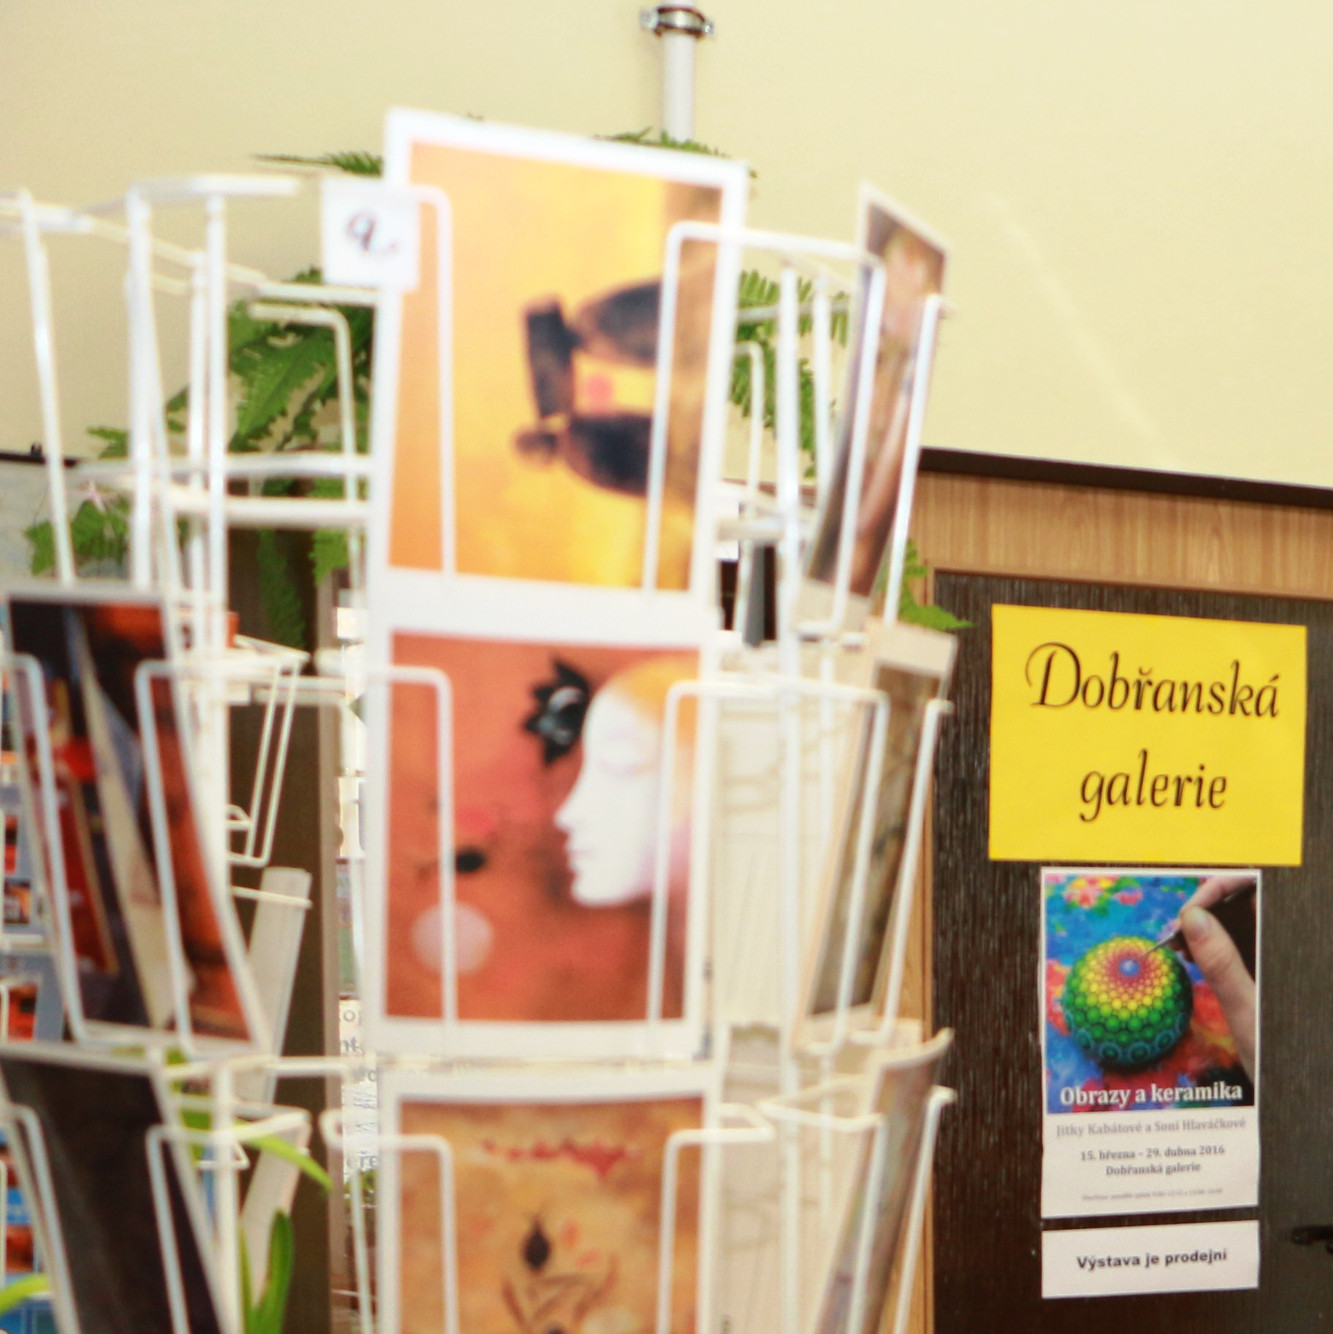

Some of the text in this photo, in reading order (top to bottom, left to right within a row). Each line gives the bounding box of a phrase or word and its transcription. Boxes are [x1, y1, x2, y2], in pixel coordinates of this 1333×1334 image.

[1025, 641, 1280, 718] Dobřanská
[1079, 748, 1227, 822] galerie
[1060, 1080, 1243, 1108] Obrazy a keramika
[1056, 1123, 1084, 1138] Jitky
[1087, 1121, 1143, 1136] Kabátové
[1182, 1115, 1247, 1131] Hlaváčkové
[1080, 1150, 1096, 1162] 15.
[1099, 1147, 1136, 1161] března
[1164, 1144, 1197, 1158] dubna
[1199, 1144, 1226, 1156] 2016
[1105, 1161, 1201, 1176] Dobřanská galerie
[1077, 1248, 1227, 1271] Výstava je prodejní
